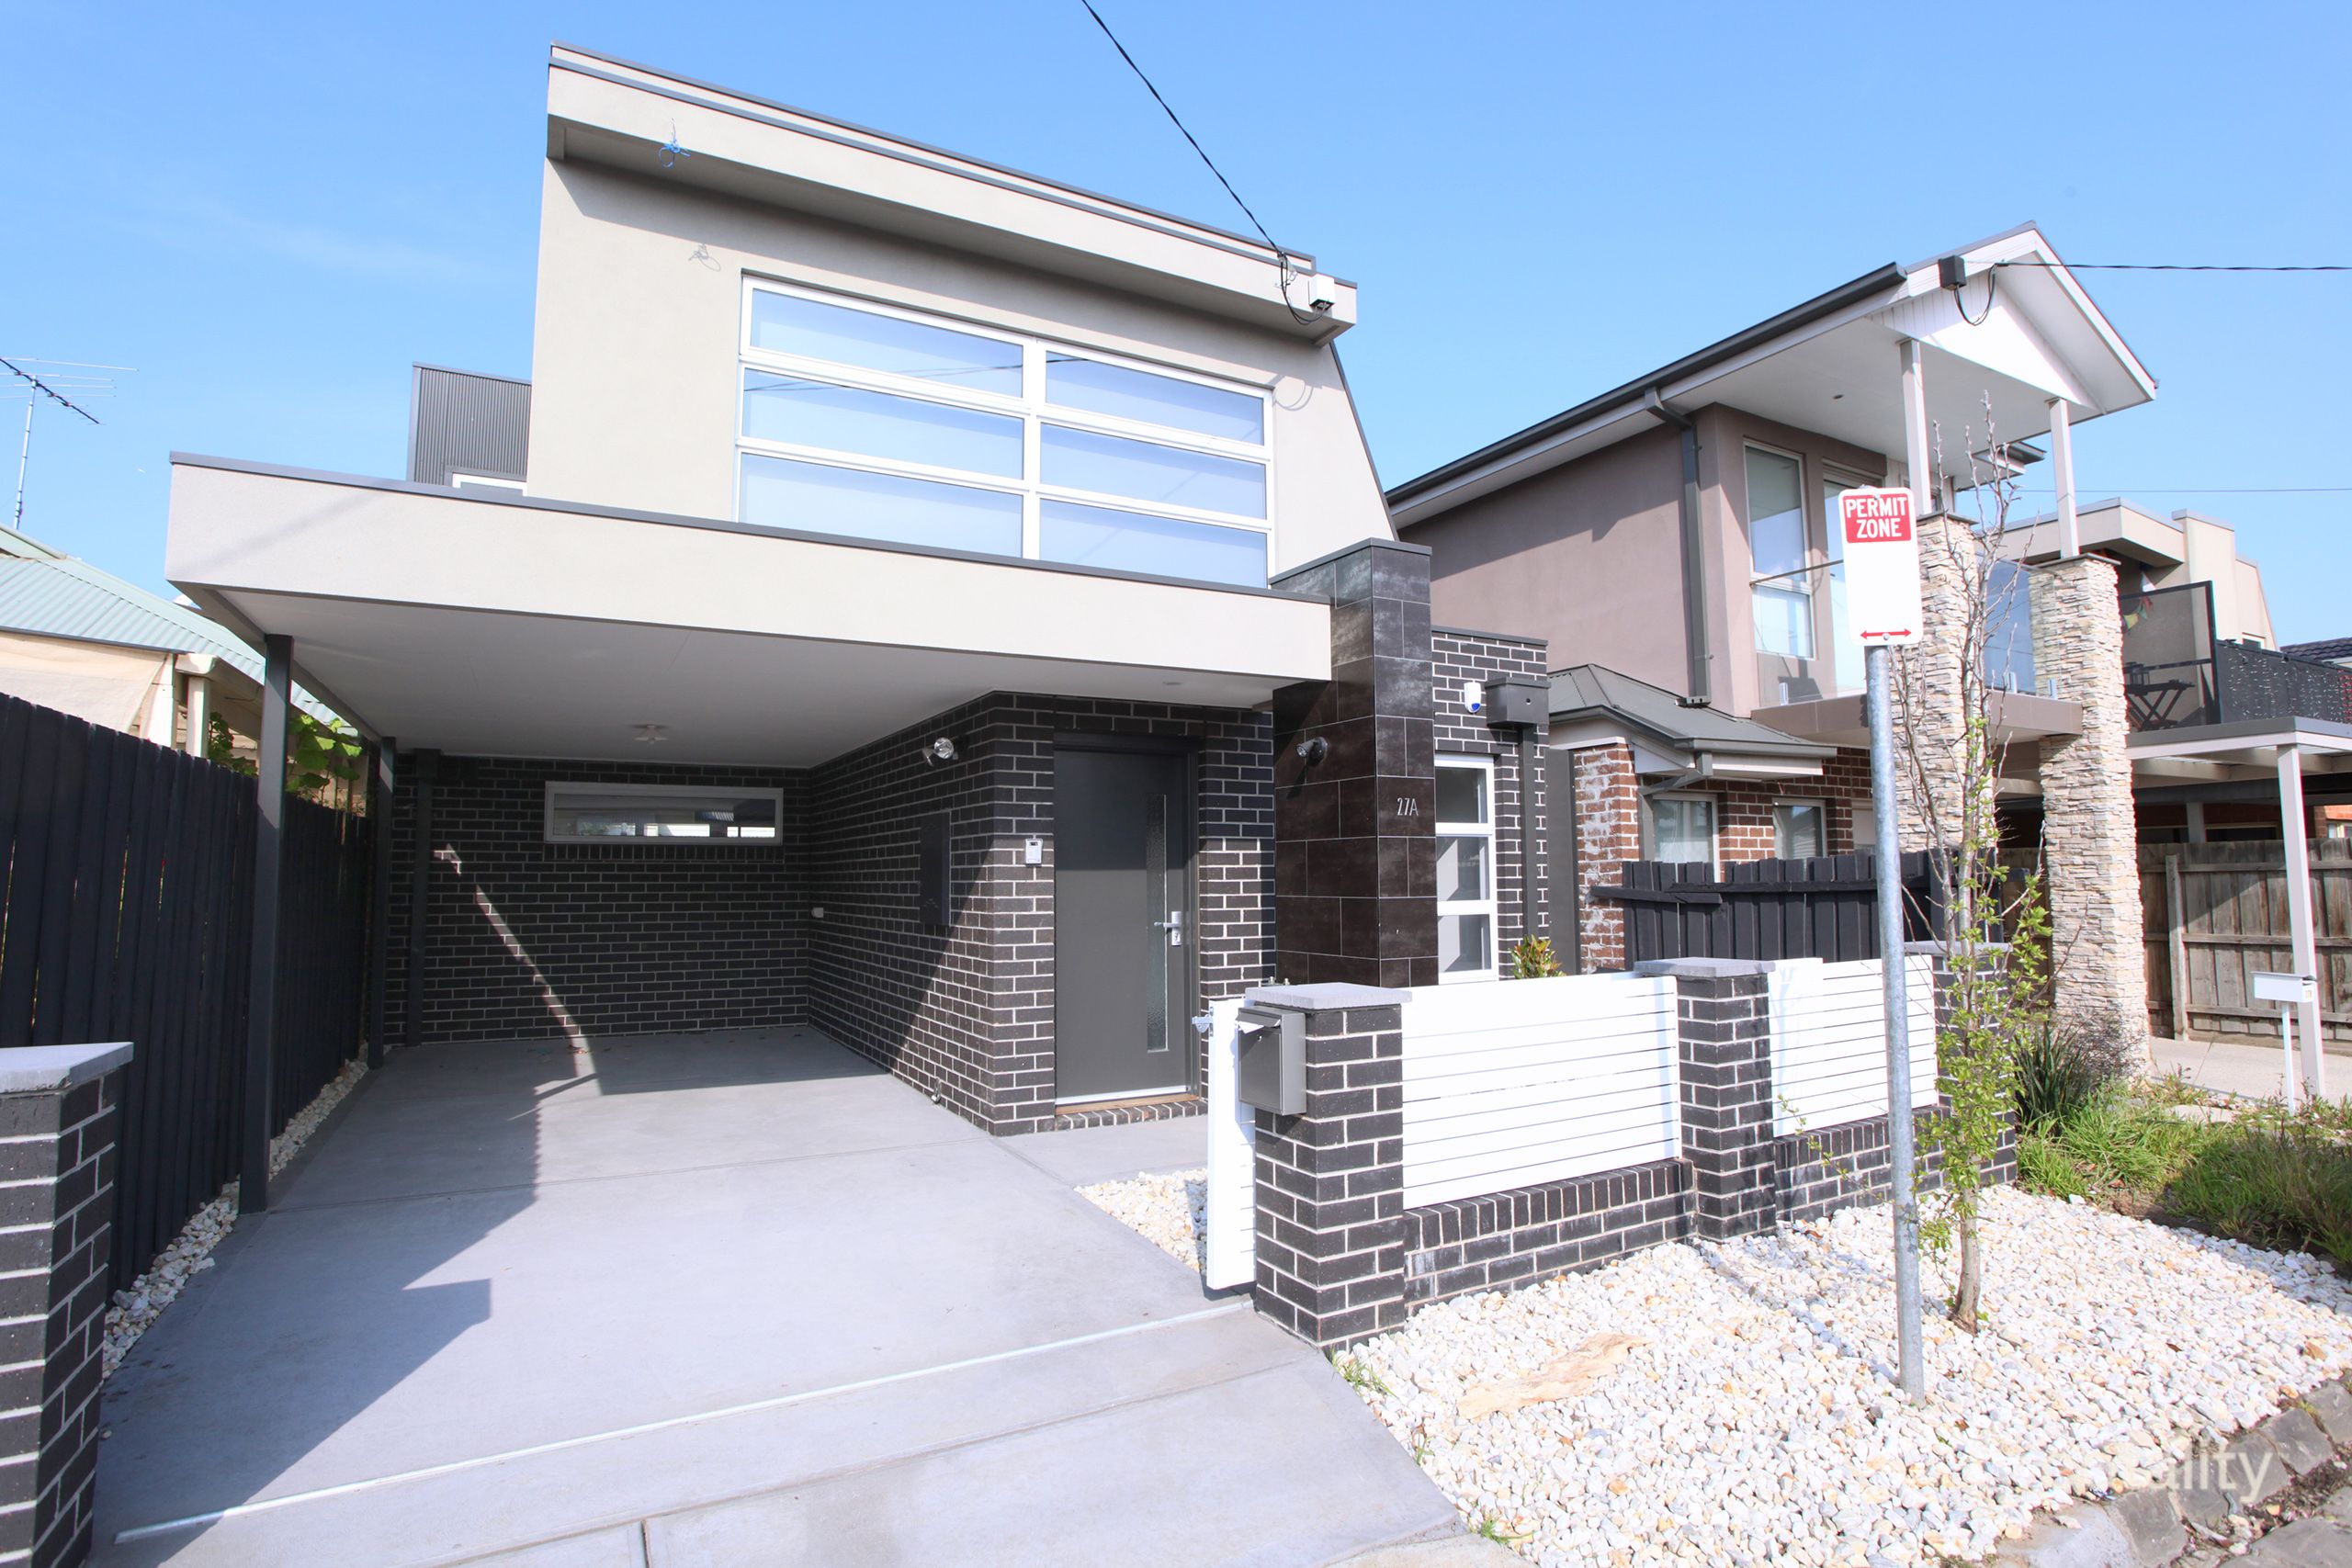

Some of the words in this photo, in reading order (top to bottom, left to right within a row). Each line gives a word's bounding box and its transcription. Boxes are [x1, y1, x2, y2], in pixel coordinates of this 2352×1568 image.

[1845, 496, 1907, 518] PERMIT
[1856, 518, 1902, 538] ZONE
[1396, 797, 1419, 816] 27A
